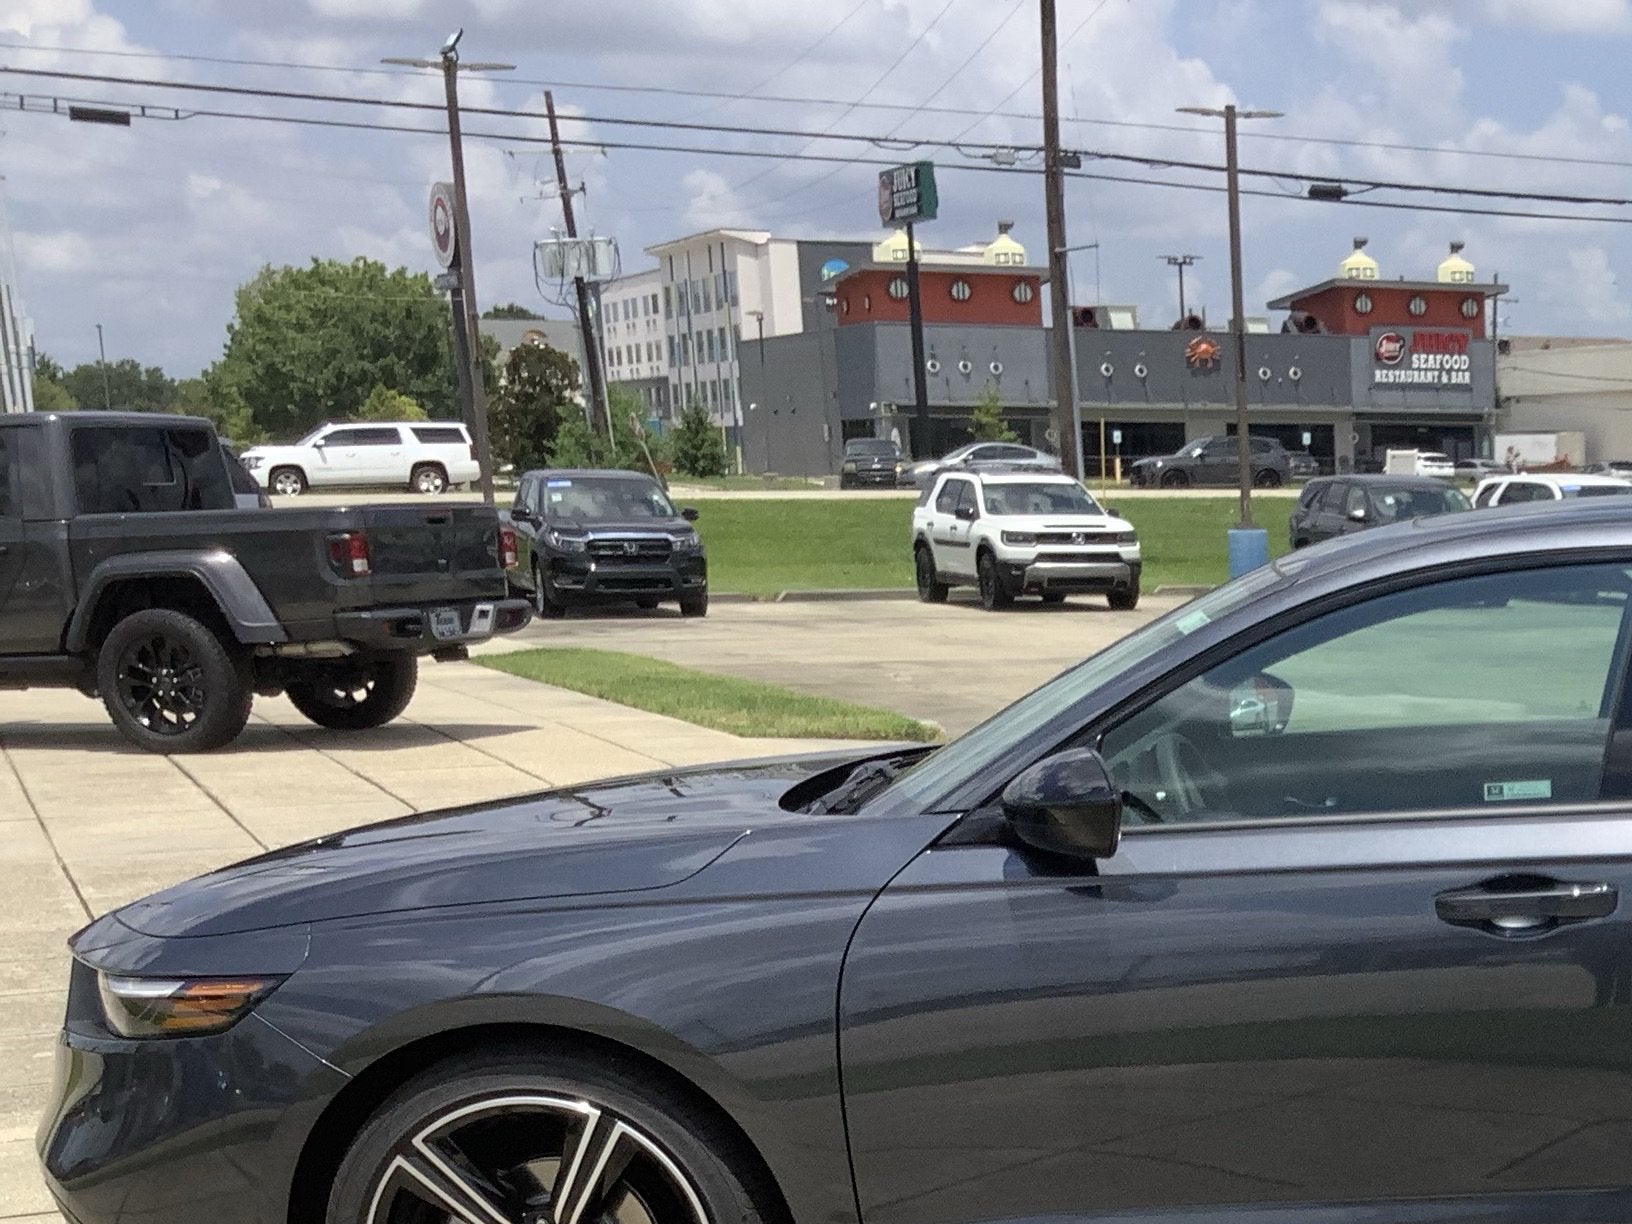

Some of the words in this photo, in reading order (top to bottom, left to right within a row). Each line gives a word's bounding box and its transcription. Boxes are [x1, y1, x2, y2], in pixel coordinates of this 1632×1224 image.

[1412, 354, 1469, 369] SEAFOOD
[1375, 370, 1438, 383] RESTAURANT
[1441, 371, 1449, 384] &
[1451, 371, 1470, 384] BAR
